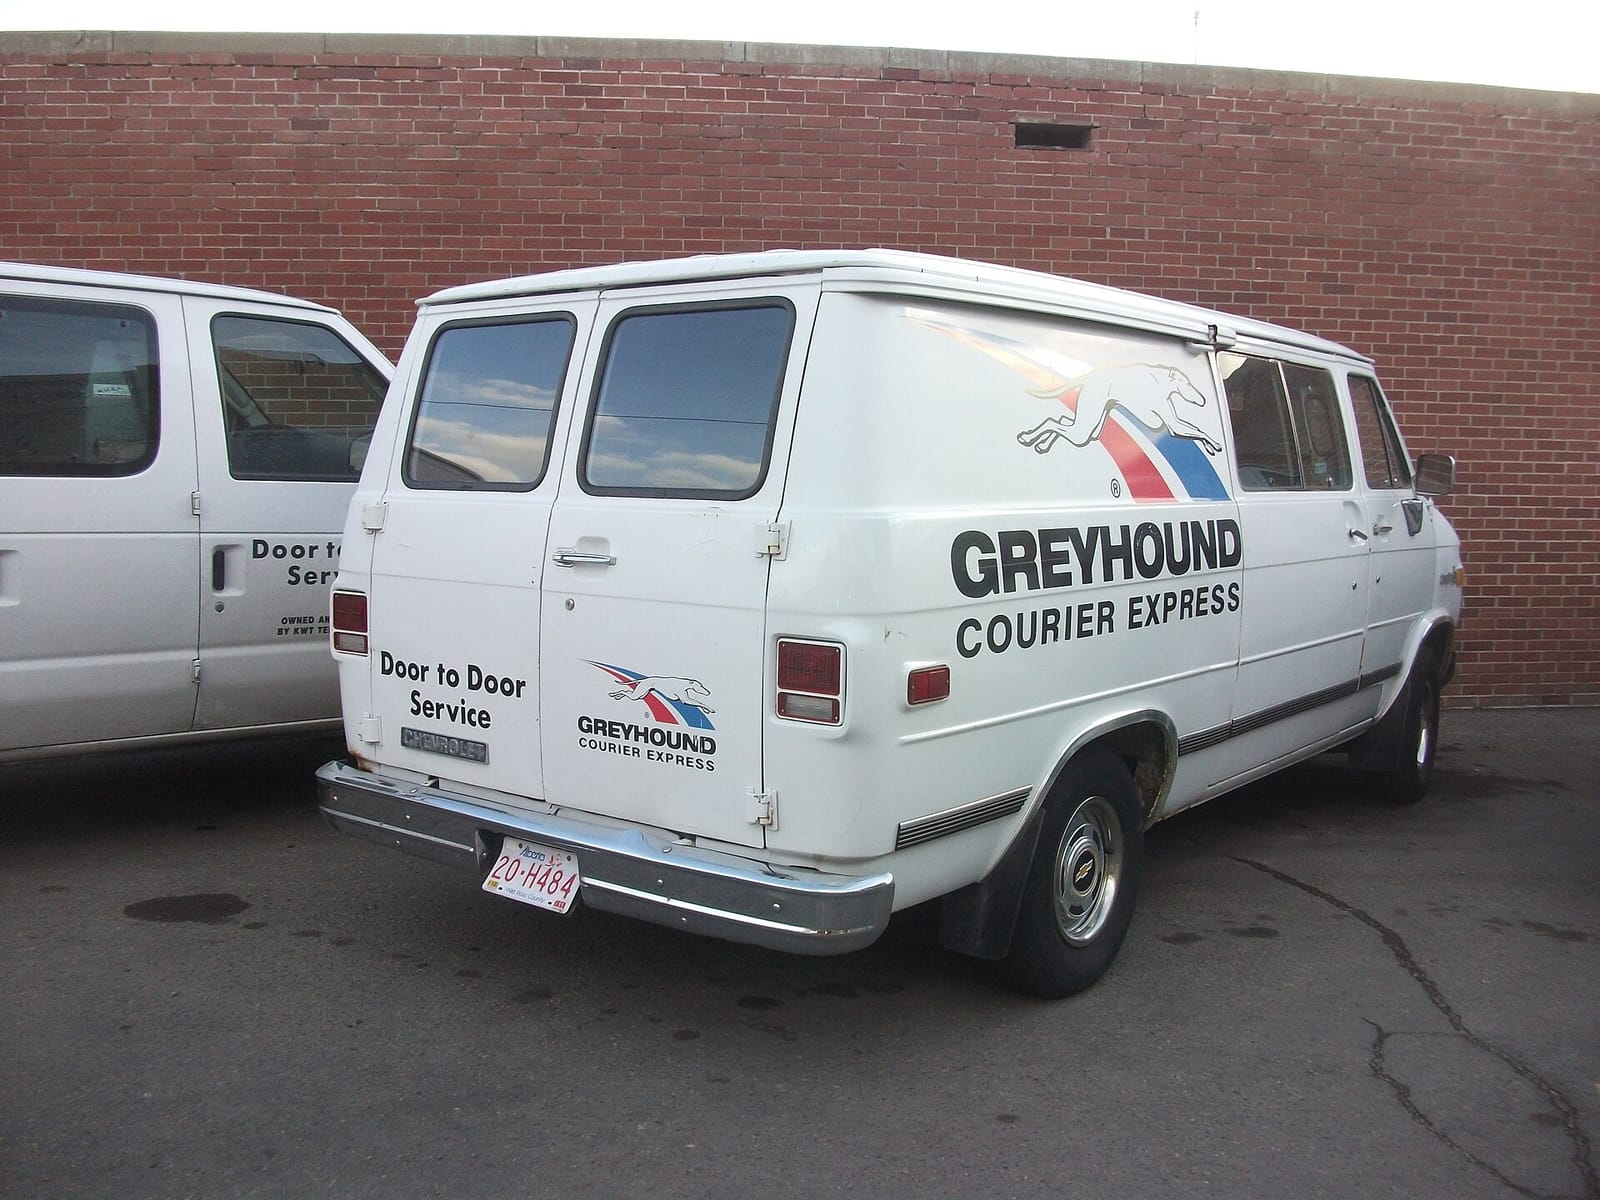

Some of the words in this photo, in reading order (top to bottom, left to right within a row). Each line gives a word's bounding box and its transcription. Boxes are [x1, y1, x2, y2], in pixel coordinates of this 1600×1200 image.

[252, 539, 319, 559] Door
[326, 541, 341, 559] t
[950, 518, 1242, 599] GREYHOUND
[277, 627, 290, 636] BY
[293, 626, 315, 635] KWT
[281, 616, 315, 625] OWNED
[956, 600, 1114, 659] COURIER
[1128, 582, 1240, 630] EXPRESS
[380, 650, 430, 683] Door
[437, 663, 459, 688] to
[467, 664, 526, 699] Door
[410, 690, 492, 729] Service
[403, 730, 485, 760] CHEVROLET
[577, 715, 717, 755] GREYHOUND
[578, 737, 641, 758] COURIER
[647, 749, 715, 772] EXPRESS
